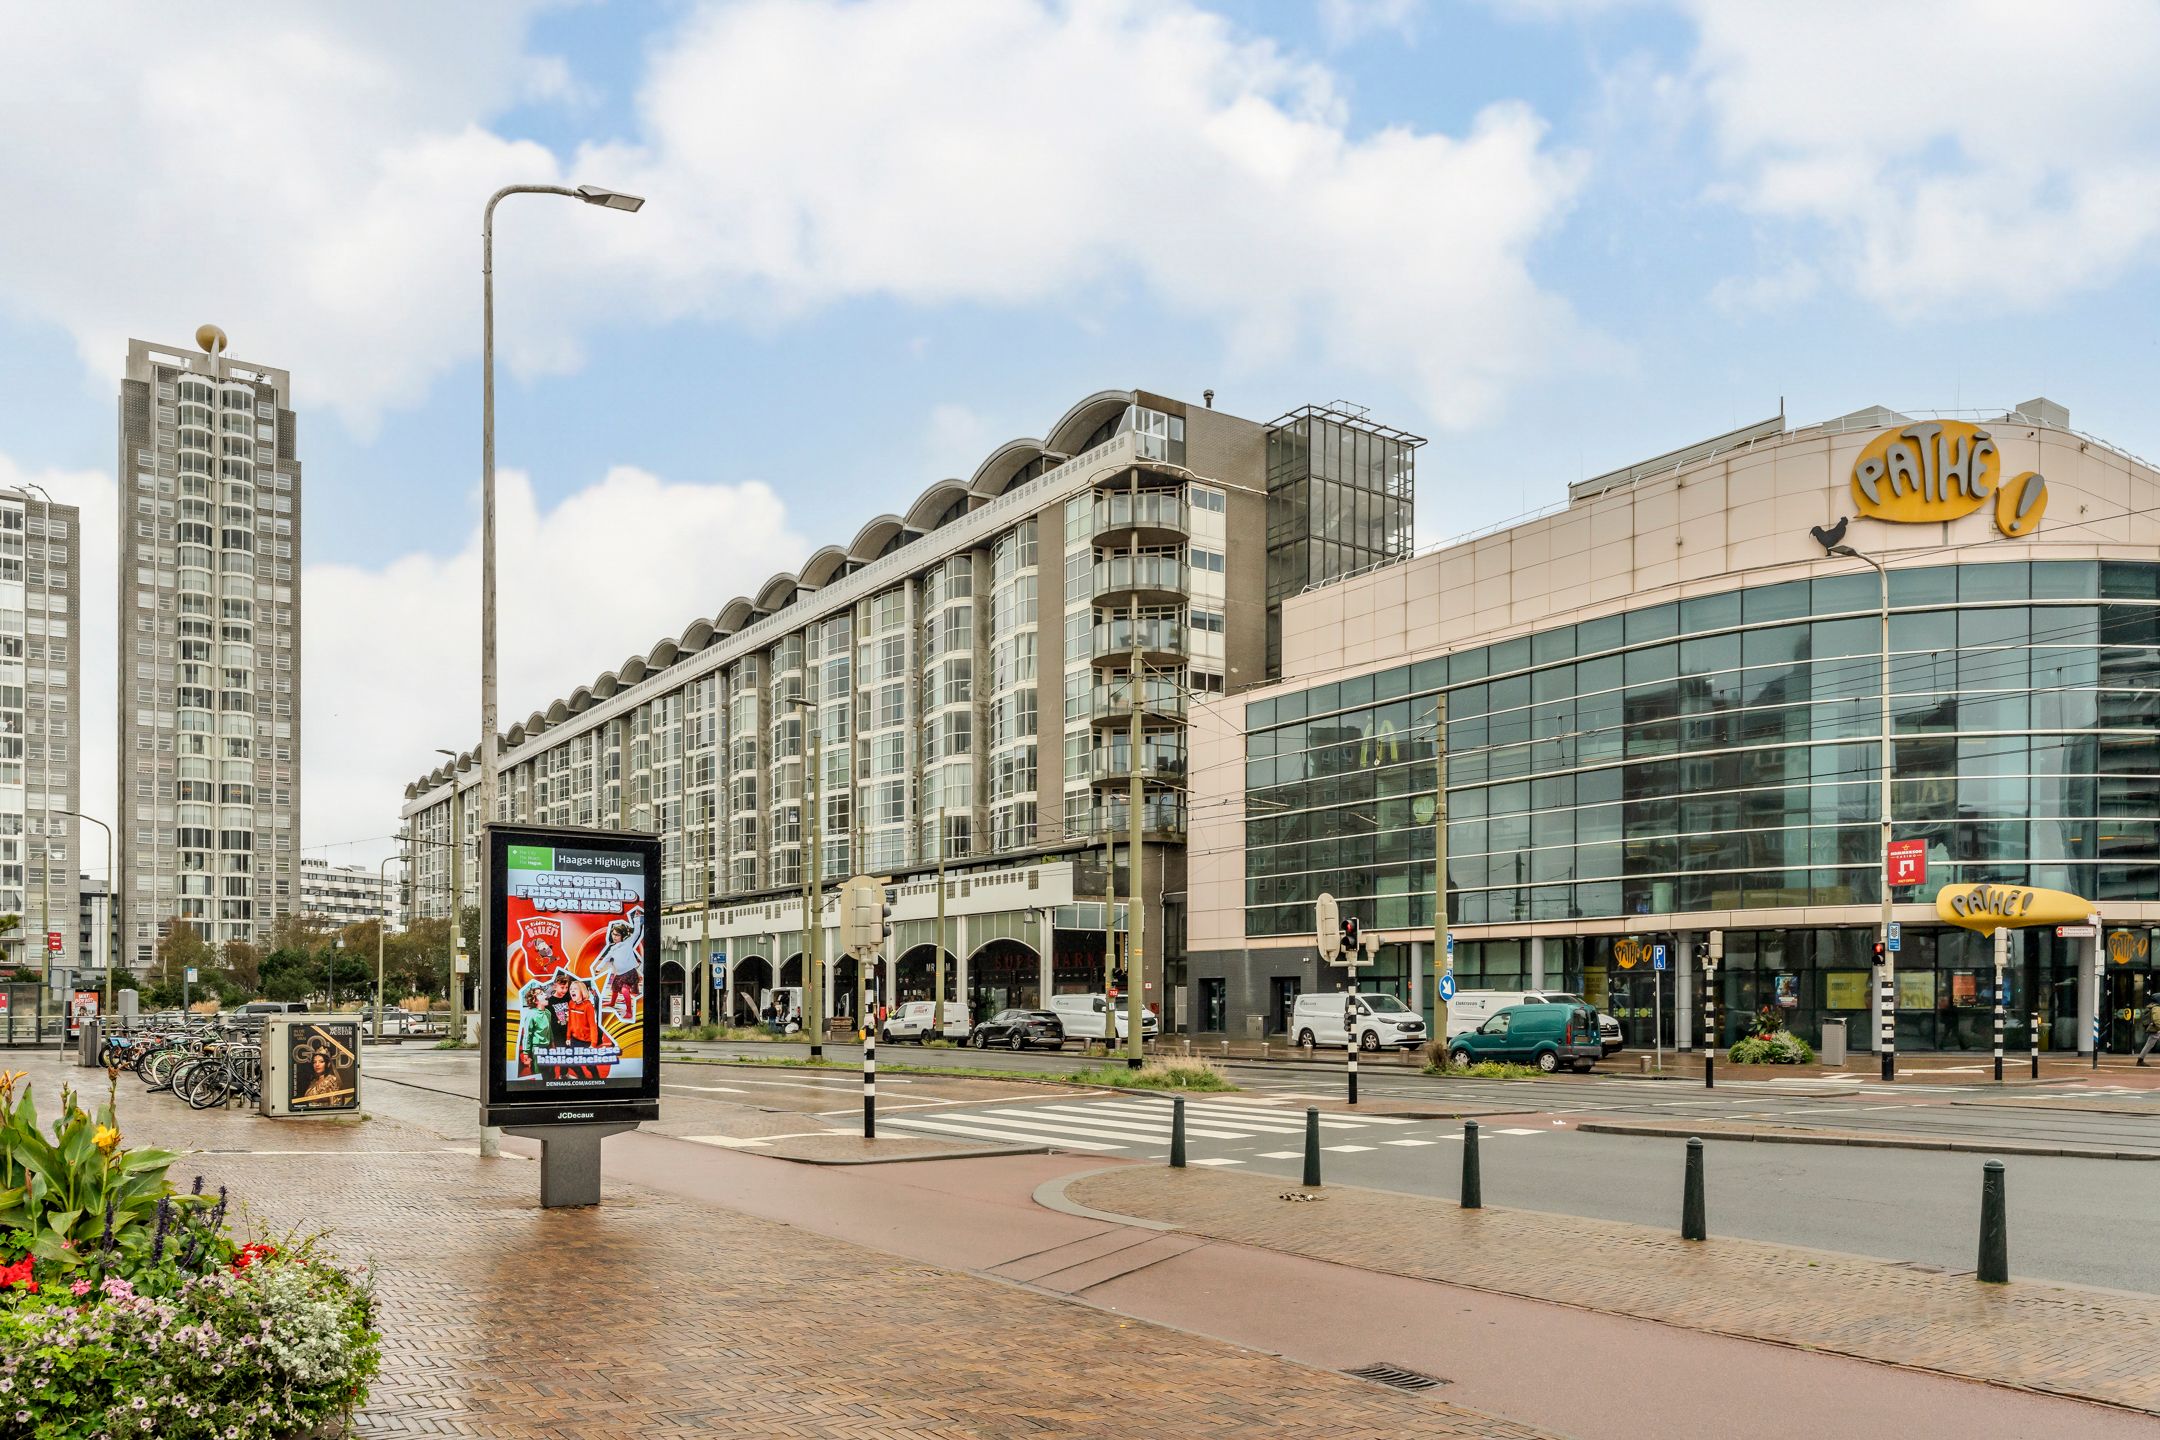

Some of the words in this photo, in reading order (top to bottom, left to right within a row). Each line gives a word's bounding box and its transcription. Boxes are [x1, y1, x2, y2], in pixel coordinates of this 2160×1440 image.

[558, 855, 593, 866] Haagse
[594, 857, 641, 868] Highlights
[536, 874, 619, 889] OKTOBER
[516, 885, 638, 901] FEESTMAAND
[532, 898, 579, 911] VOOR
[580, 900, 622, 912] KIDS
[1656, 947, 1663, 960] P
[533, 1046, 548, 1055] In
[549, 1047, 573, 1055] alle
[573, 1046, 620, 1056] Haagse
[536, 1055, 618, 1064] bibliotheken
